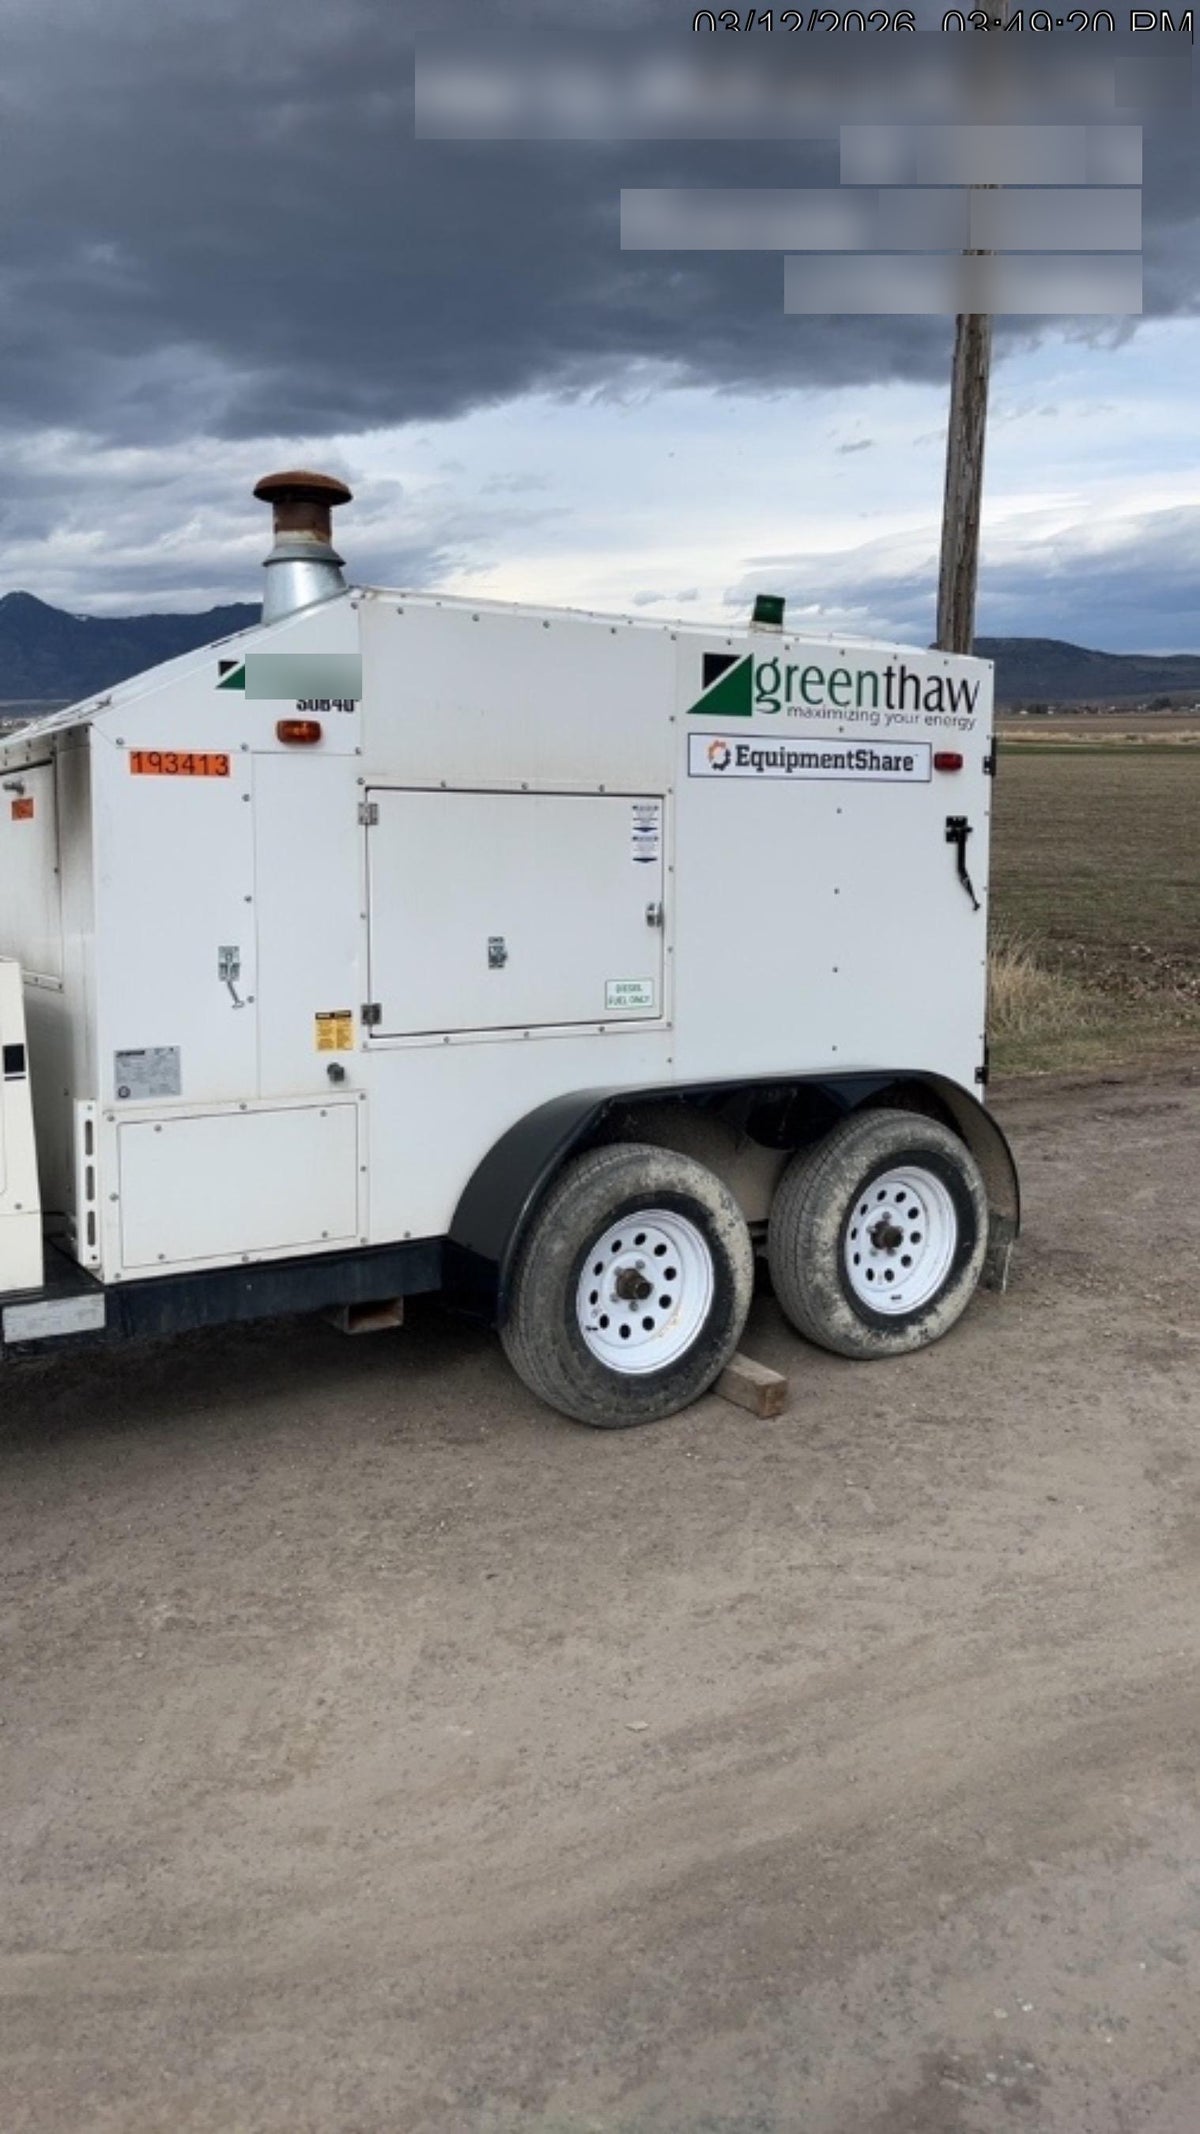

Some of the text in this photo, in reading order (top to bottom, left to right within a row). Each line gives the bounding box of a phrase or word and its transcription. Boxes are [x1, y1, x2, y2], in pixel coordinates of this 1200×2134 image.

[755, 656, 981, 715] greenthaw
[786, 704, 978, 731] maximizing your energy
[131, 751, 229, 776] 193413
[735, 743, 914, 773] EquipmentShare
